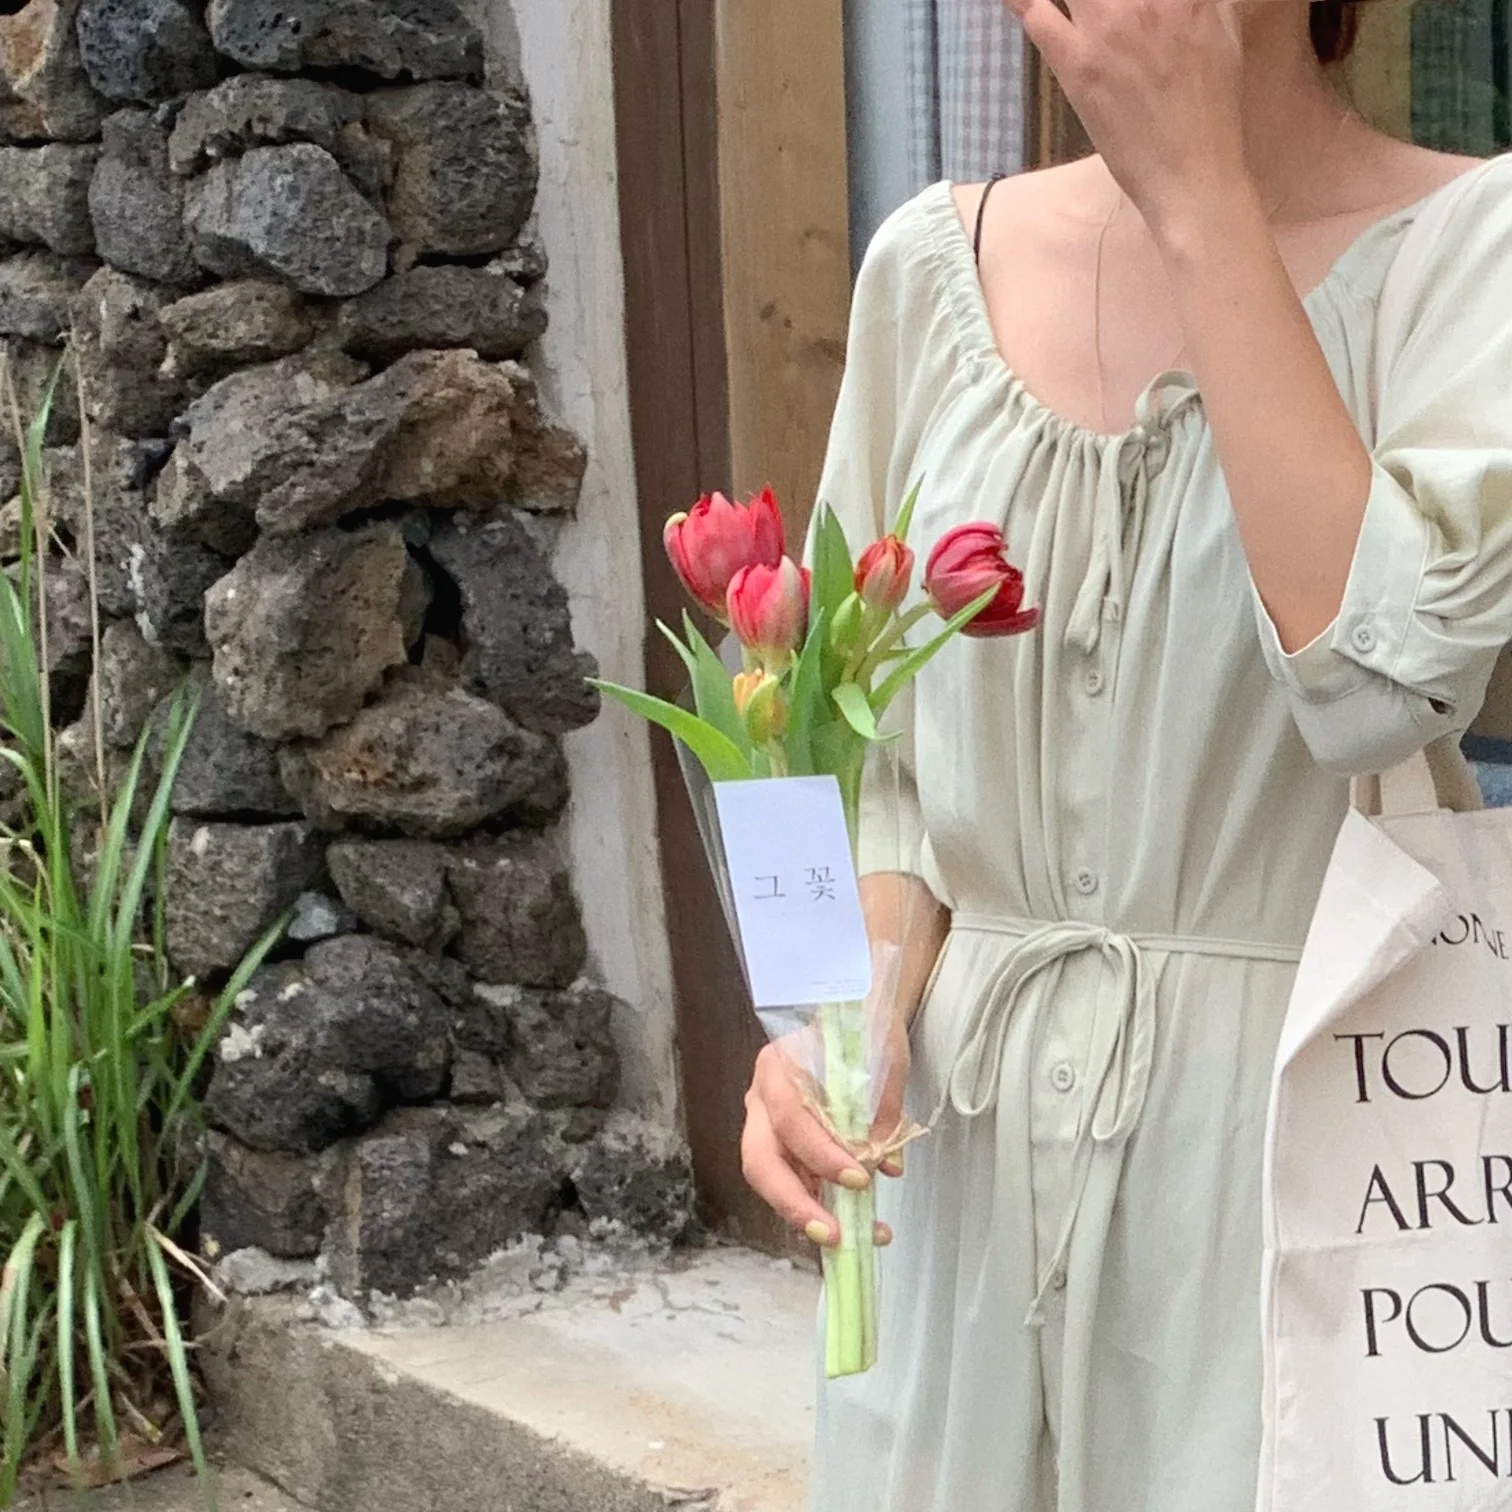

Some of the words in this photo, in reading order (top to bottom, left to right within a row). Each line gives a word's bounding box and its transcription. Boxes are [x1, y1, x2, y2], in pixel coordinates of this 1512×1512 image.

[753, 874, 786, 899] 그
[804, 866, 836, 900] 꽃
[1333, 1023, 1512, 1103] TOU
